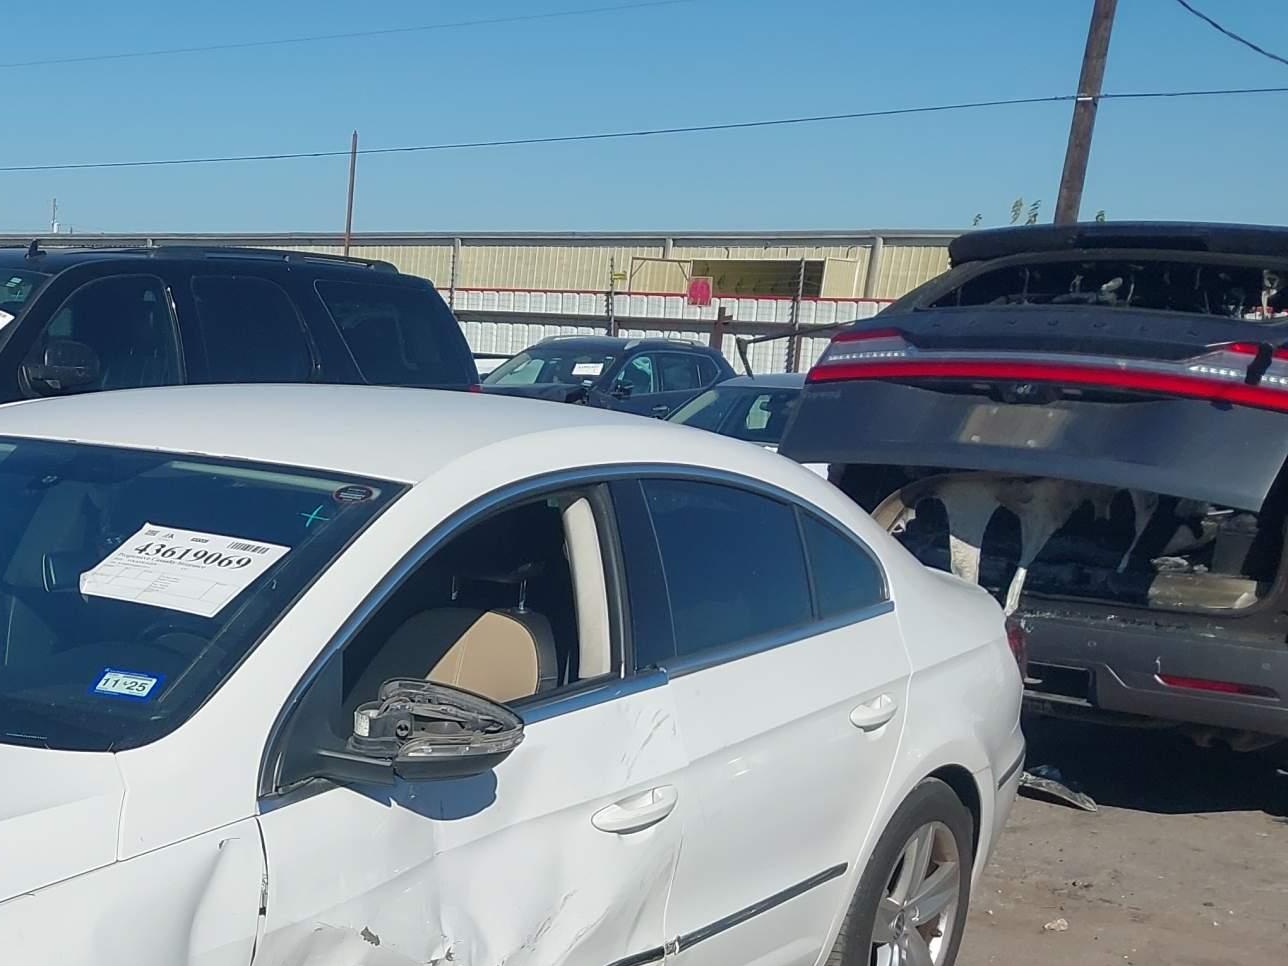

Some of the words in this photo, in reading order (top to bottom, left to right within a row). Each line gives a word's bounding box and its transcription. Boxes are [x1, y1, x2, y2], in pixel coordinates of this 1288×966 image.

[134, 541, 252, 570] 43619069
[102, 677, 120, 688] 11
[125, 680, 149, 692] 25
